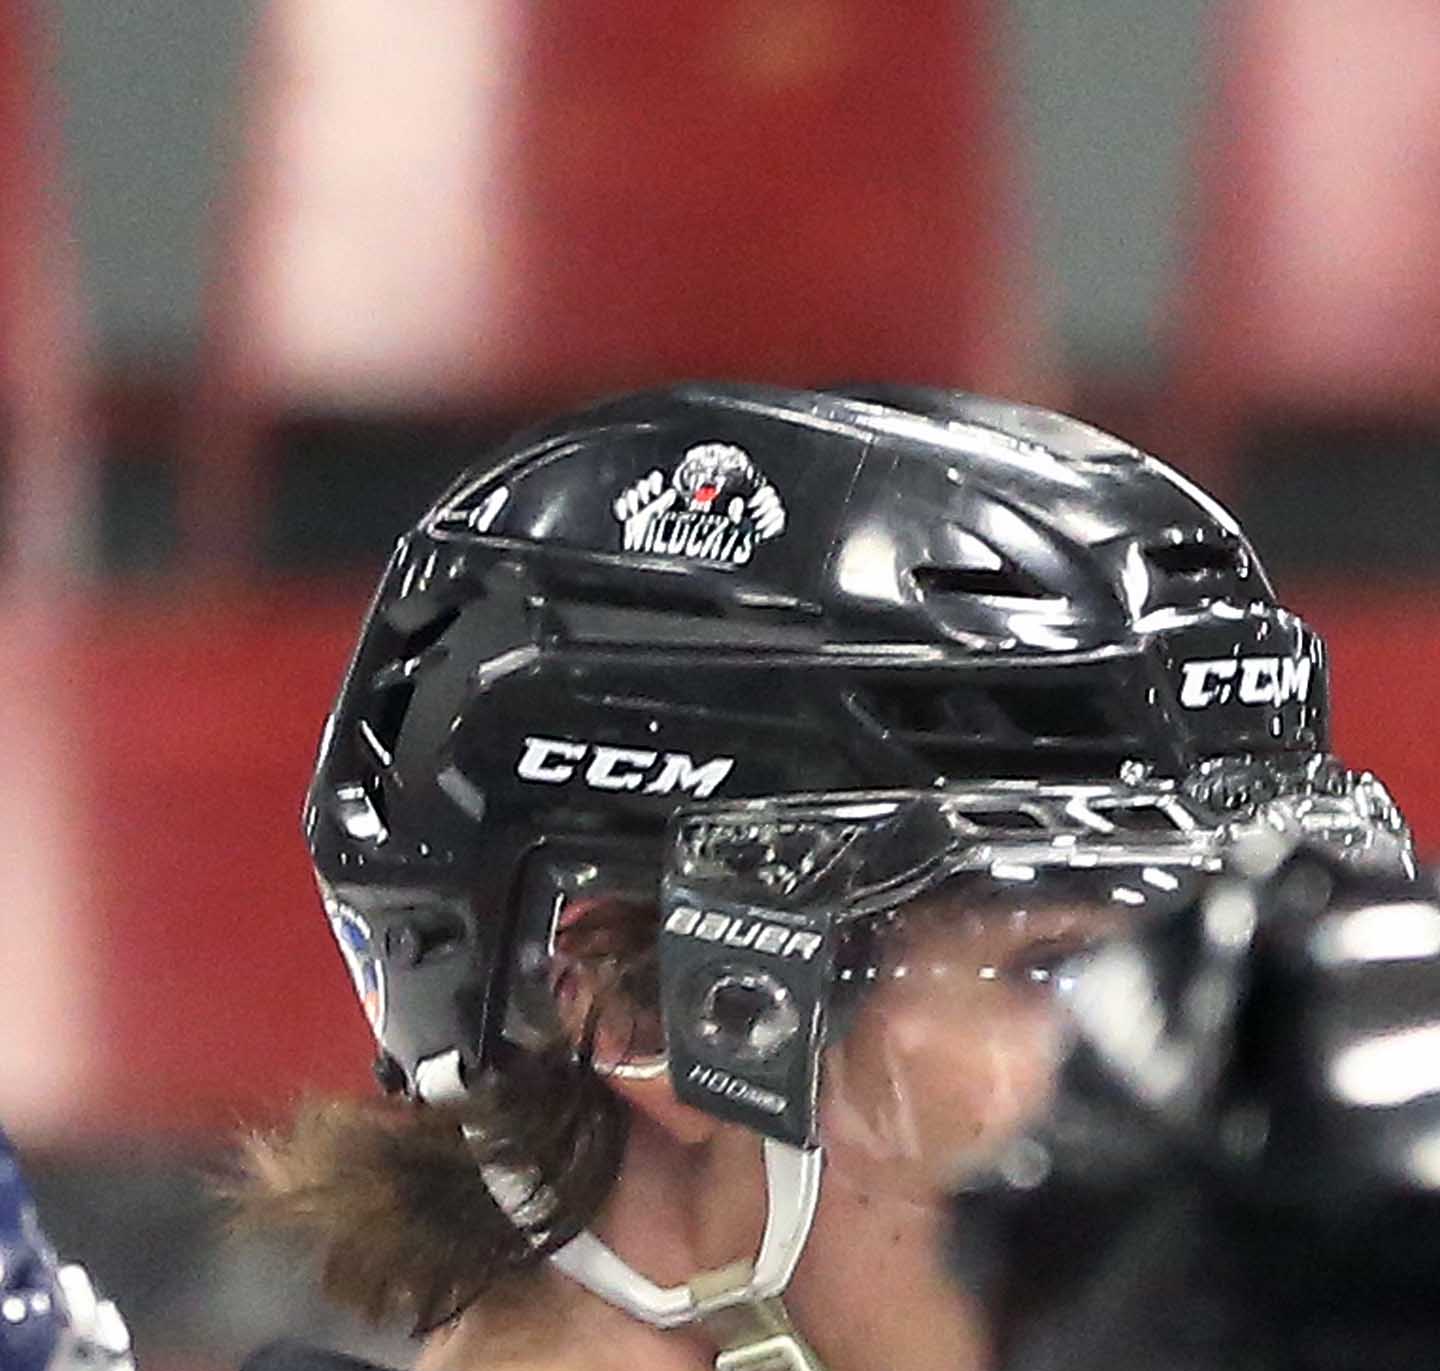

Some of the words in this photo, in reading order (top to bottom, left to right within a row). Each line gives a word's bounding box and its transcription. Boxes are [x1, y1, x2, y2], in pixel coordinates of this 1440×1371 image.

[624, 511, 751, 563] WILDCATS
[1180, 656, 1311, 707] CCM
[517, 737, 734, 798] CCM
[664, 907, 822, 960] BAUER
